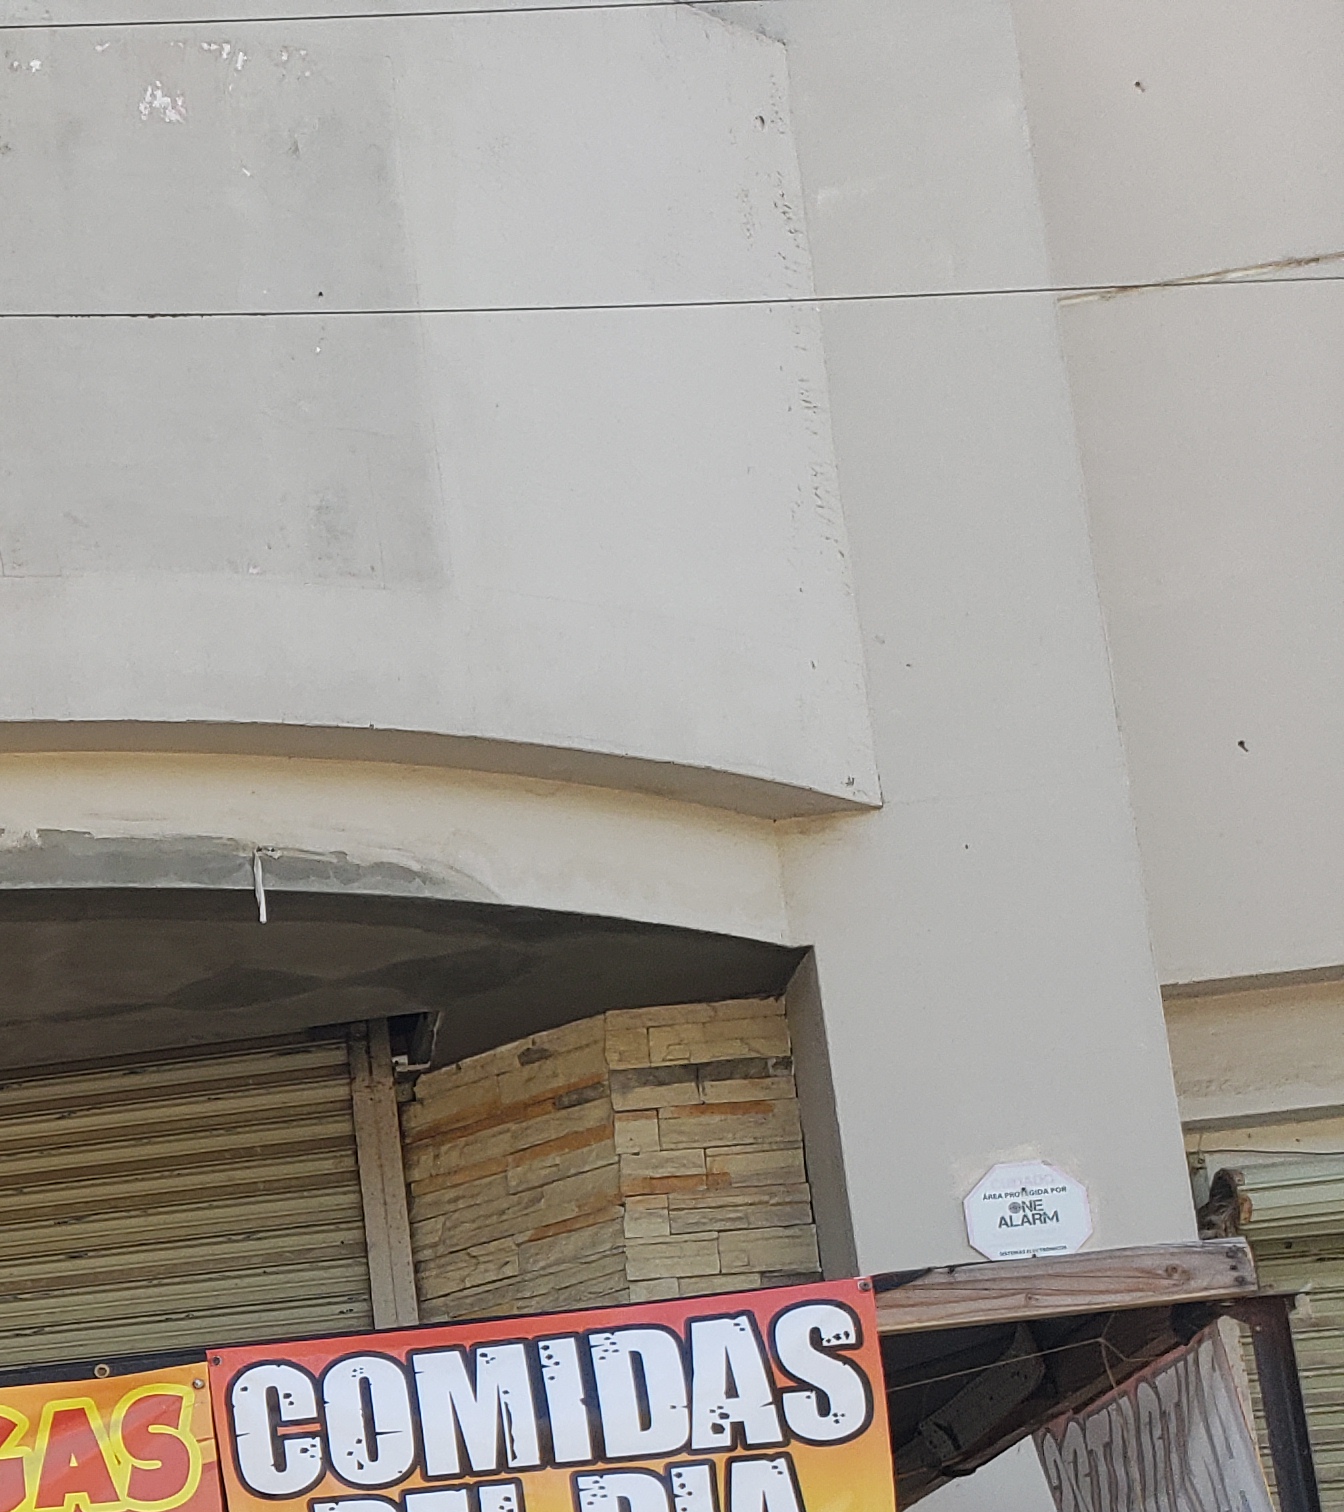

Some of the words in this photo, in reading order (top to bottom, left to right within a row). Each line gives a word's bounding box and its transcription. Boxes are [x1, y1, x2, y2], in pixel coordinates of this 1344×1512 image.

[983, 1191, 1003, 1201] ÁREA
[1051, 1186, 1067, 1194] POR
[998, 1210, 1059, 1228] ALARM
[227, 1301, 874, 1500] COMIDAS
